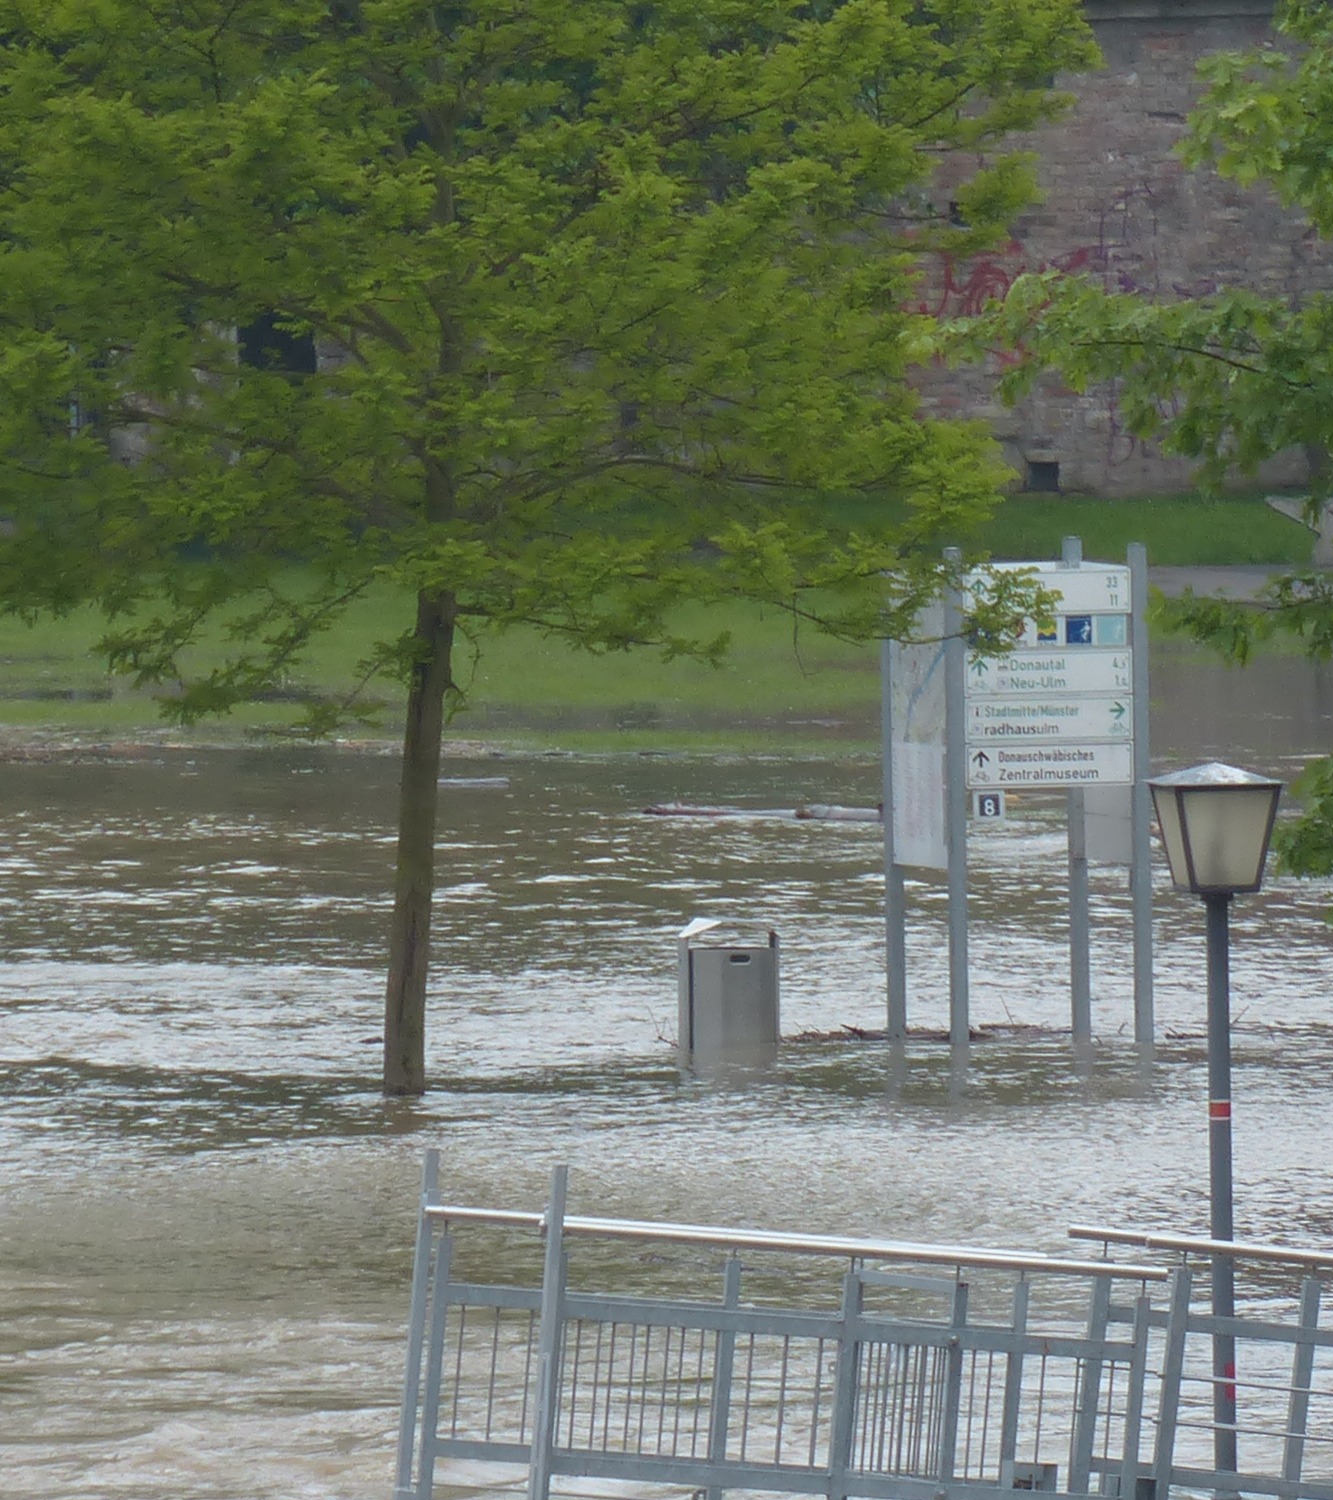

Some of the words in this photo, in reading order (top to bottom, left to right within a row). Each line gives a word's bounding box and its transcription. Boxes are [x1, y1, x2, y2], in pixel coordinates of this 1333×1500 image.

[1106, 576, 1118, 589] 33
[1109, 594, 1119, 607] 11
[1010, 658, 1066, 671] Donautal
[1010, 676, 1066, 689] Neu-Ulm
[984, 722, 1060, 736] radhausulm
[998, 768, 1100, 781] Zentralmuseum
[984, 798, 995, 816] 8
